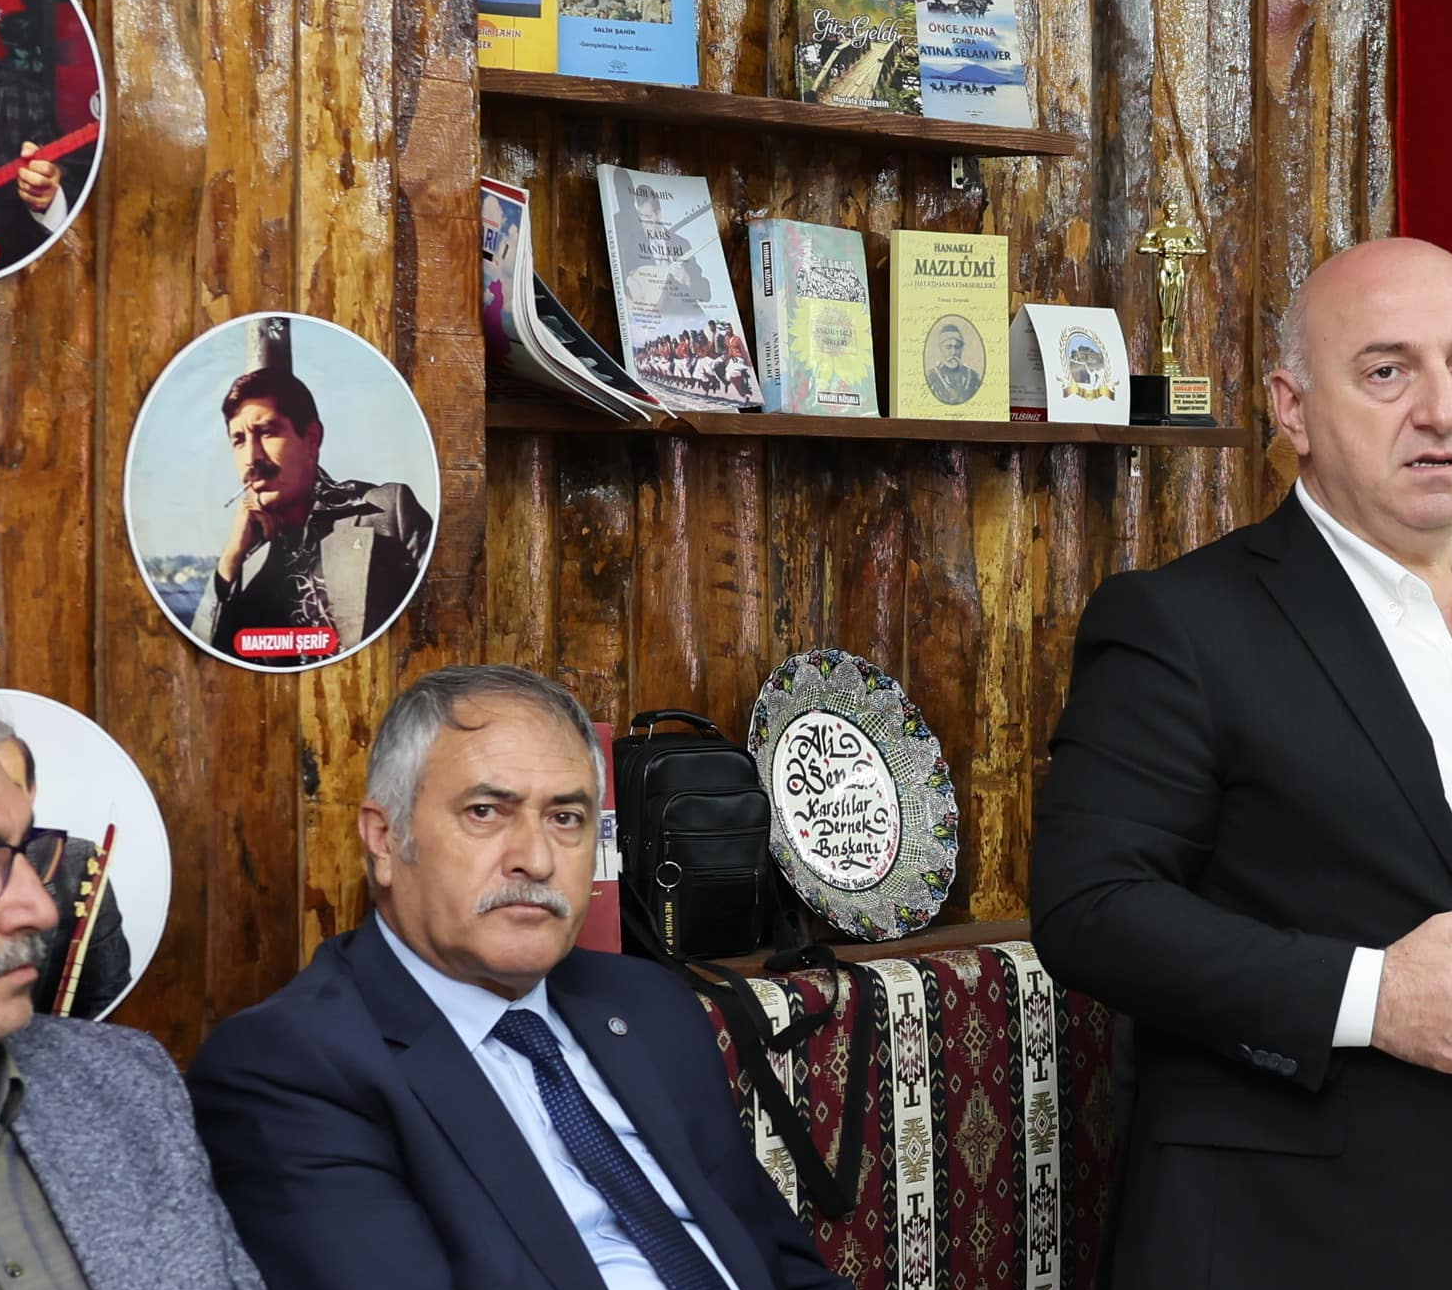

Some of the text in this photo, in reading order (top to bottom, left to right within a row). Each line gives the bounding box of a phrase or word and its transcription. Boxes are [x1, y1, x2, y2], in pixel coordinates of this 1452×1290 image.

[812, 8, 903, 48] Güz Geldi
[928, 21, 997, 37] ÖNCE ATANA
[951, 37, 977, 46] SONRA
[919, 45, 1012, 61] ATINA SELAM VER
[832, 94, 890, 108] Mustafa ÖZDEMİR
[646, 229, 671, 241] KARS
[638, 242, 684, 257] MANİLERİ
[934, 243, 973, 254] HANAKLI
[914, 254, 996, 278] MAZLÛMÎ
[241, 629, 330, 654] MAHZUNİ ŞERİF
[794, 795, 873, 822] Karslılar
[812, 809, 888, 837] Dernek
[810, 837, 886, 867] Başkanı
